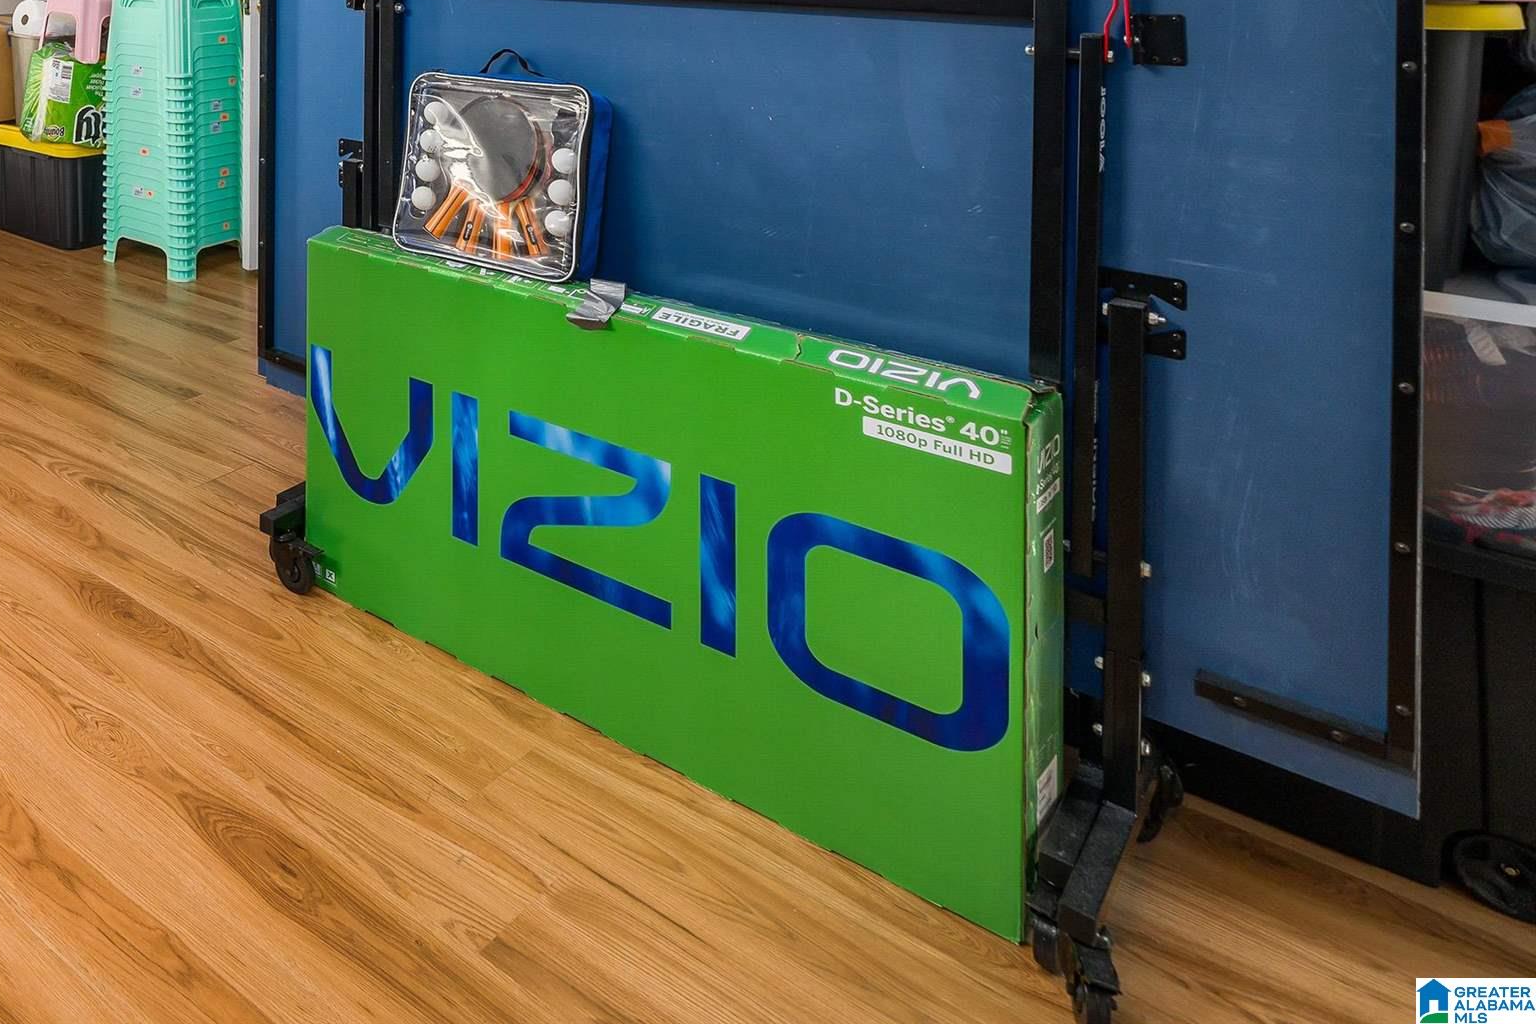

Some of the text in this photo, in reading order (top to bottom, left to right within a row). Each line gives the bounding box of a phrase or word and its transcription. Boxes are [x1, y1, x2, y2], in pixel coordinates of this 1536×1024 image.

[659, 312, 740, 337] FRAGILE
[828, 349, 981, 399] VIZIO
[876, 424, 995, 465] 1080p Full HD
[310, 343, 1011, 753] VIZIO
